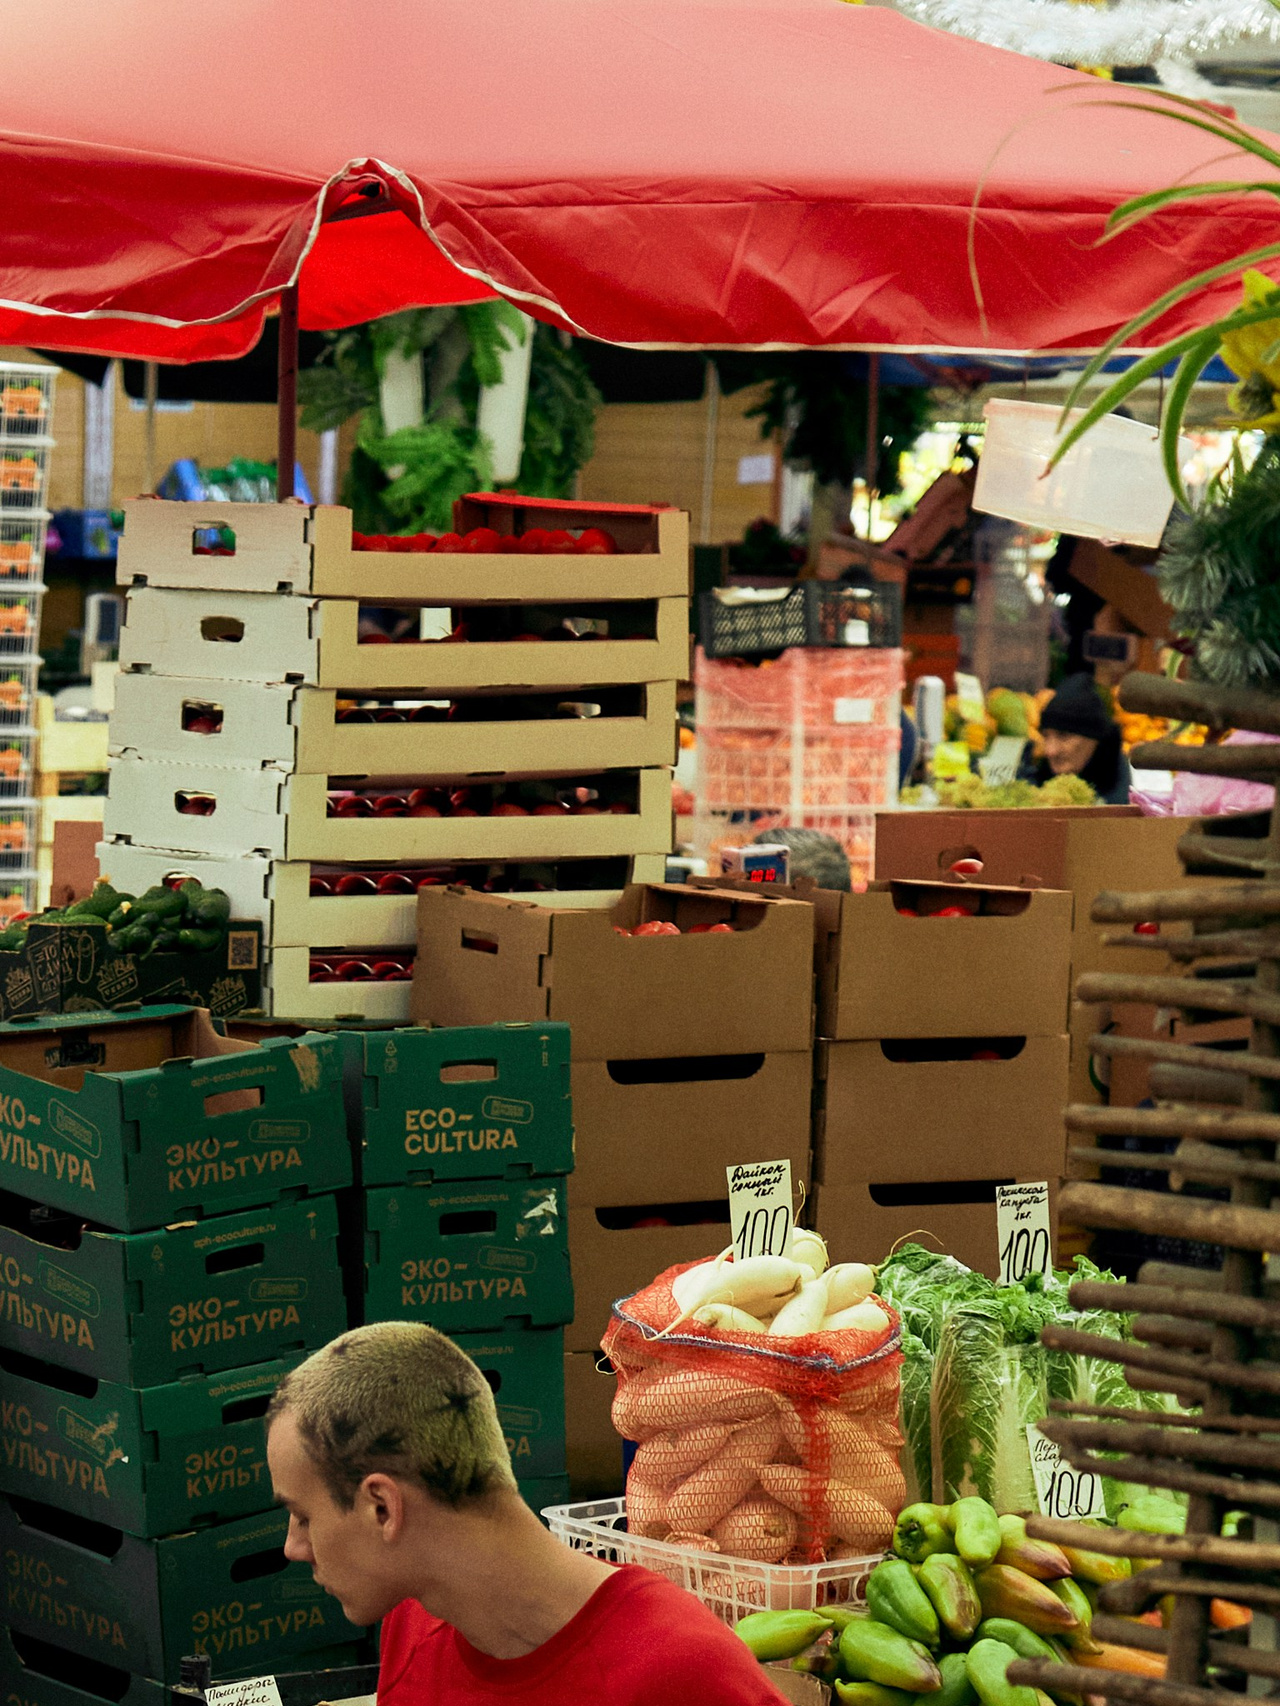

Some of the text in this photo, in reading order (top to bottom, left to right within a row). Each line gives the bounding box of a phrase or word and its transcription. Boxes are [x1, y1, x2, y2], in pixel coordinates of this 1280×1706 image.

[404, 1127, 518, 1155] CULTURA
[168, 1147, 302, 1192] КУЛЬТУРА
[736, 1205, 789, 1260] 100
[1001, 1228, 1049, 1283] 100
[402, 1276, 527, 1305] КУЛЬТУРА
[171, 1305, 300, 1352] КУЛЬТУРА
[1035, 1439, 1062, 1454] Пер
[1035, 1451, 1062, 1468] слад
[187, 1461, 264, 1500] КУЛЬТ
[1044, 1471, 1094, 1518] 100
[7, 1581, 128, 1650] КУЛЬТУРА
[194, 1606, 325, 1656] КУЛЬТУРА
[208, 1679, 275, 1702] Помидоры
